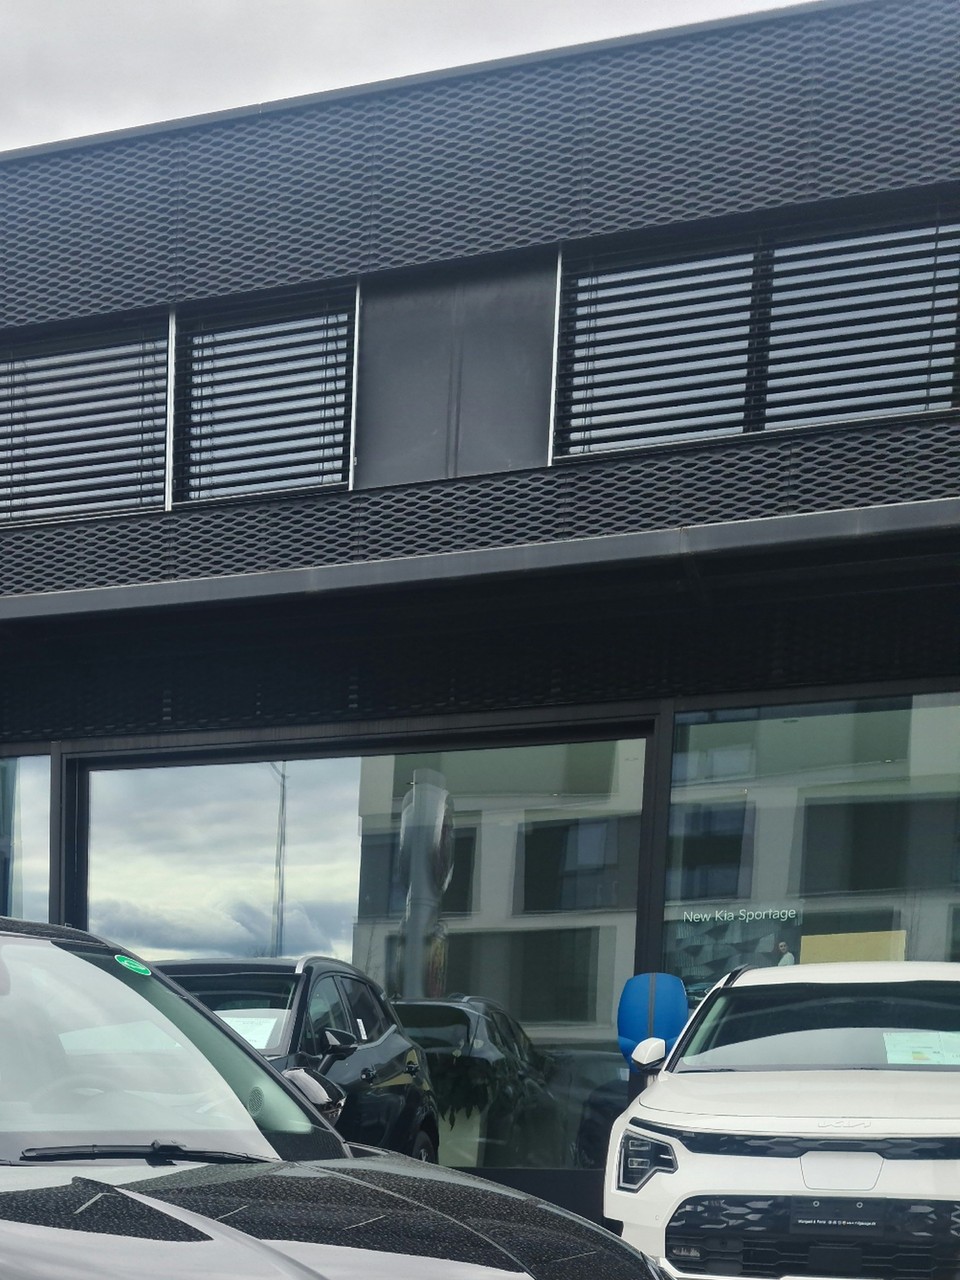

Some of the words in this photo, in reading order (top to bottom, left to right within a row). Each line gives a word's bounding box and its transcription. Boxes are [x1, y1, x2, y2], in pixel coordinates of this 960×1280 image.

[683, 911, 712, 922] New
[715, 910, 735, 921] Kia
[739, 908, 796, 923] Sportage
